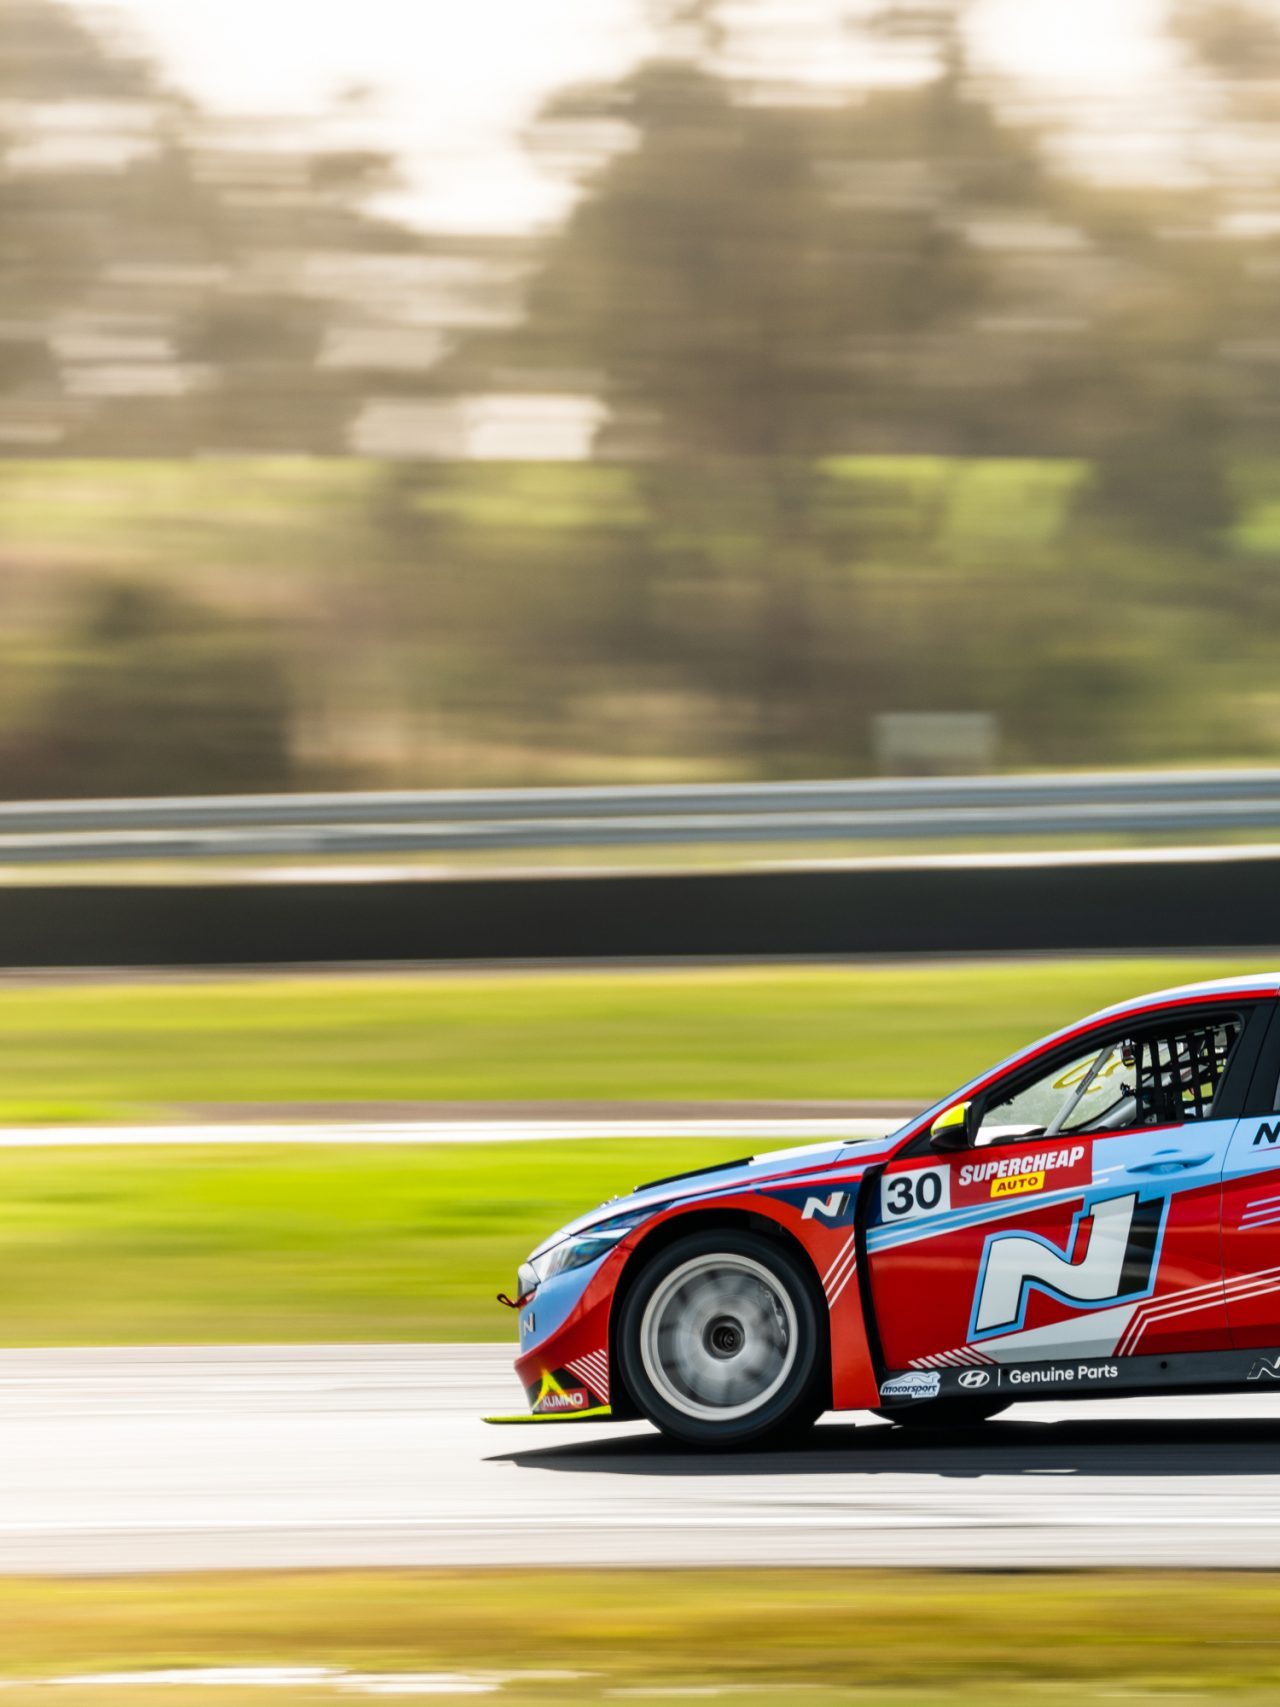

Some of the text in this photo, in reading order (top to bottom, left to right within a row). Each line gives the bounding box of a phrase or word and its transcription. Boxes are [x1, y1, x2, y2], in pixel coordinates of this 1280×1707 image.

[958, 1146, 1085, 1186] SUPERCHEAP
[887, 1171, 943, 1215] 30
[996, 1177, 1039, 1193] AUTO
[1009, 1364, 1119, 1385] Genuine Parts
[882, 1384, 938, 1396] motorsport
